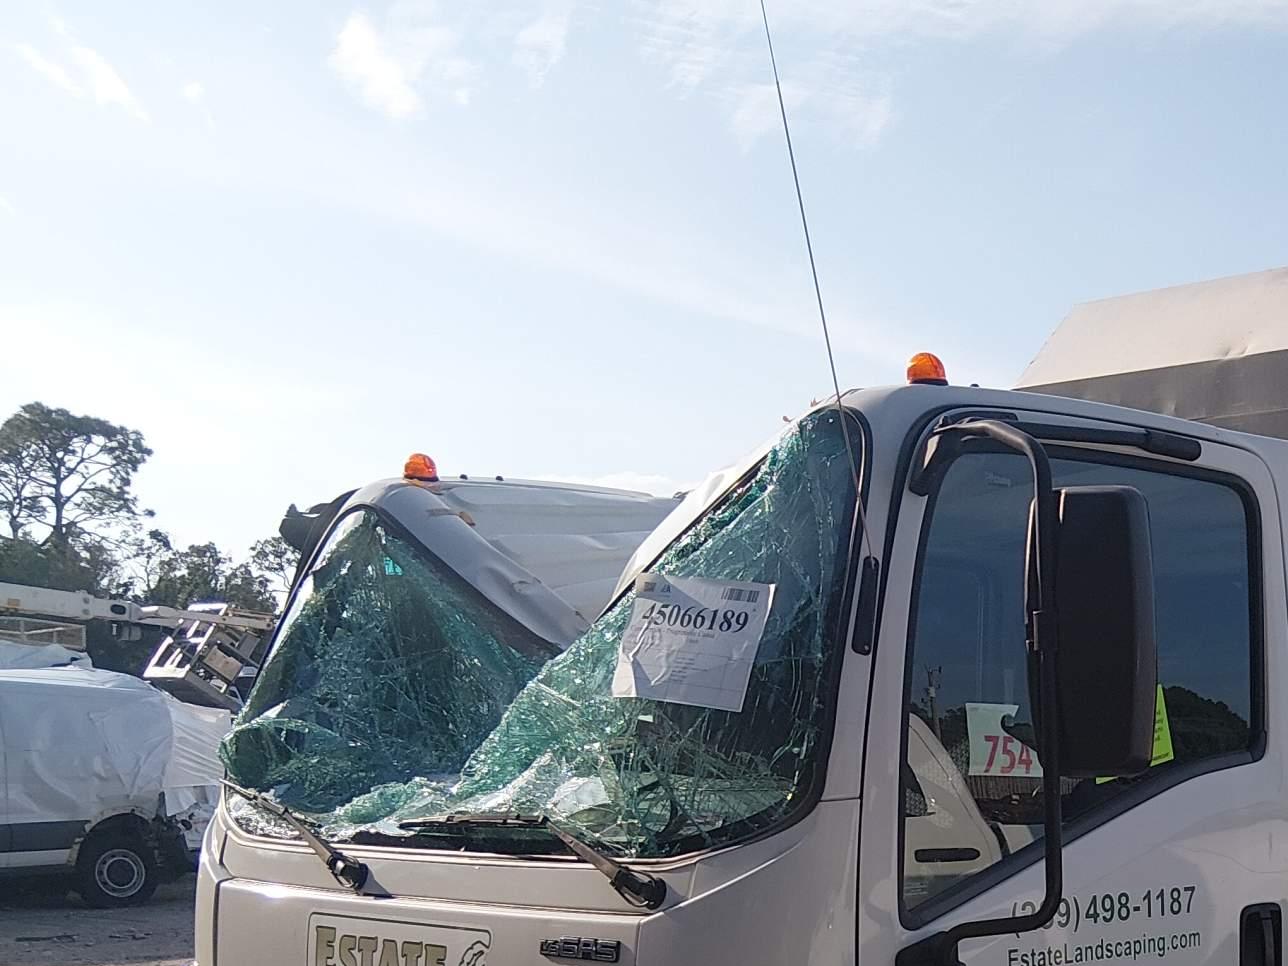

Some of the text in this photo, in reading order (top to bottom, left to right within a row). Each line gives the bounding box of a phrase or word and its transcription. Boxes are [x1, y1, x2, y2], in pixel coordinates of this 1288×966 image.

[642, 603, 749, 633] 45066189
[983, 735, 1034, 774] 754
[1085, 886, 1197, 925] 498-1187
